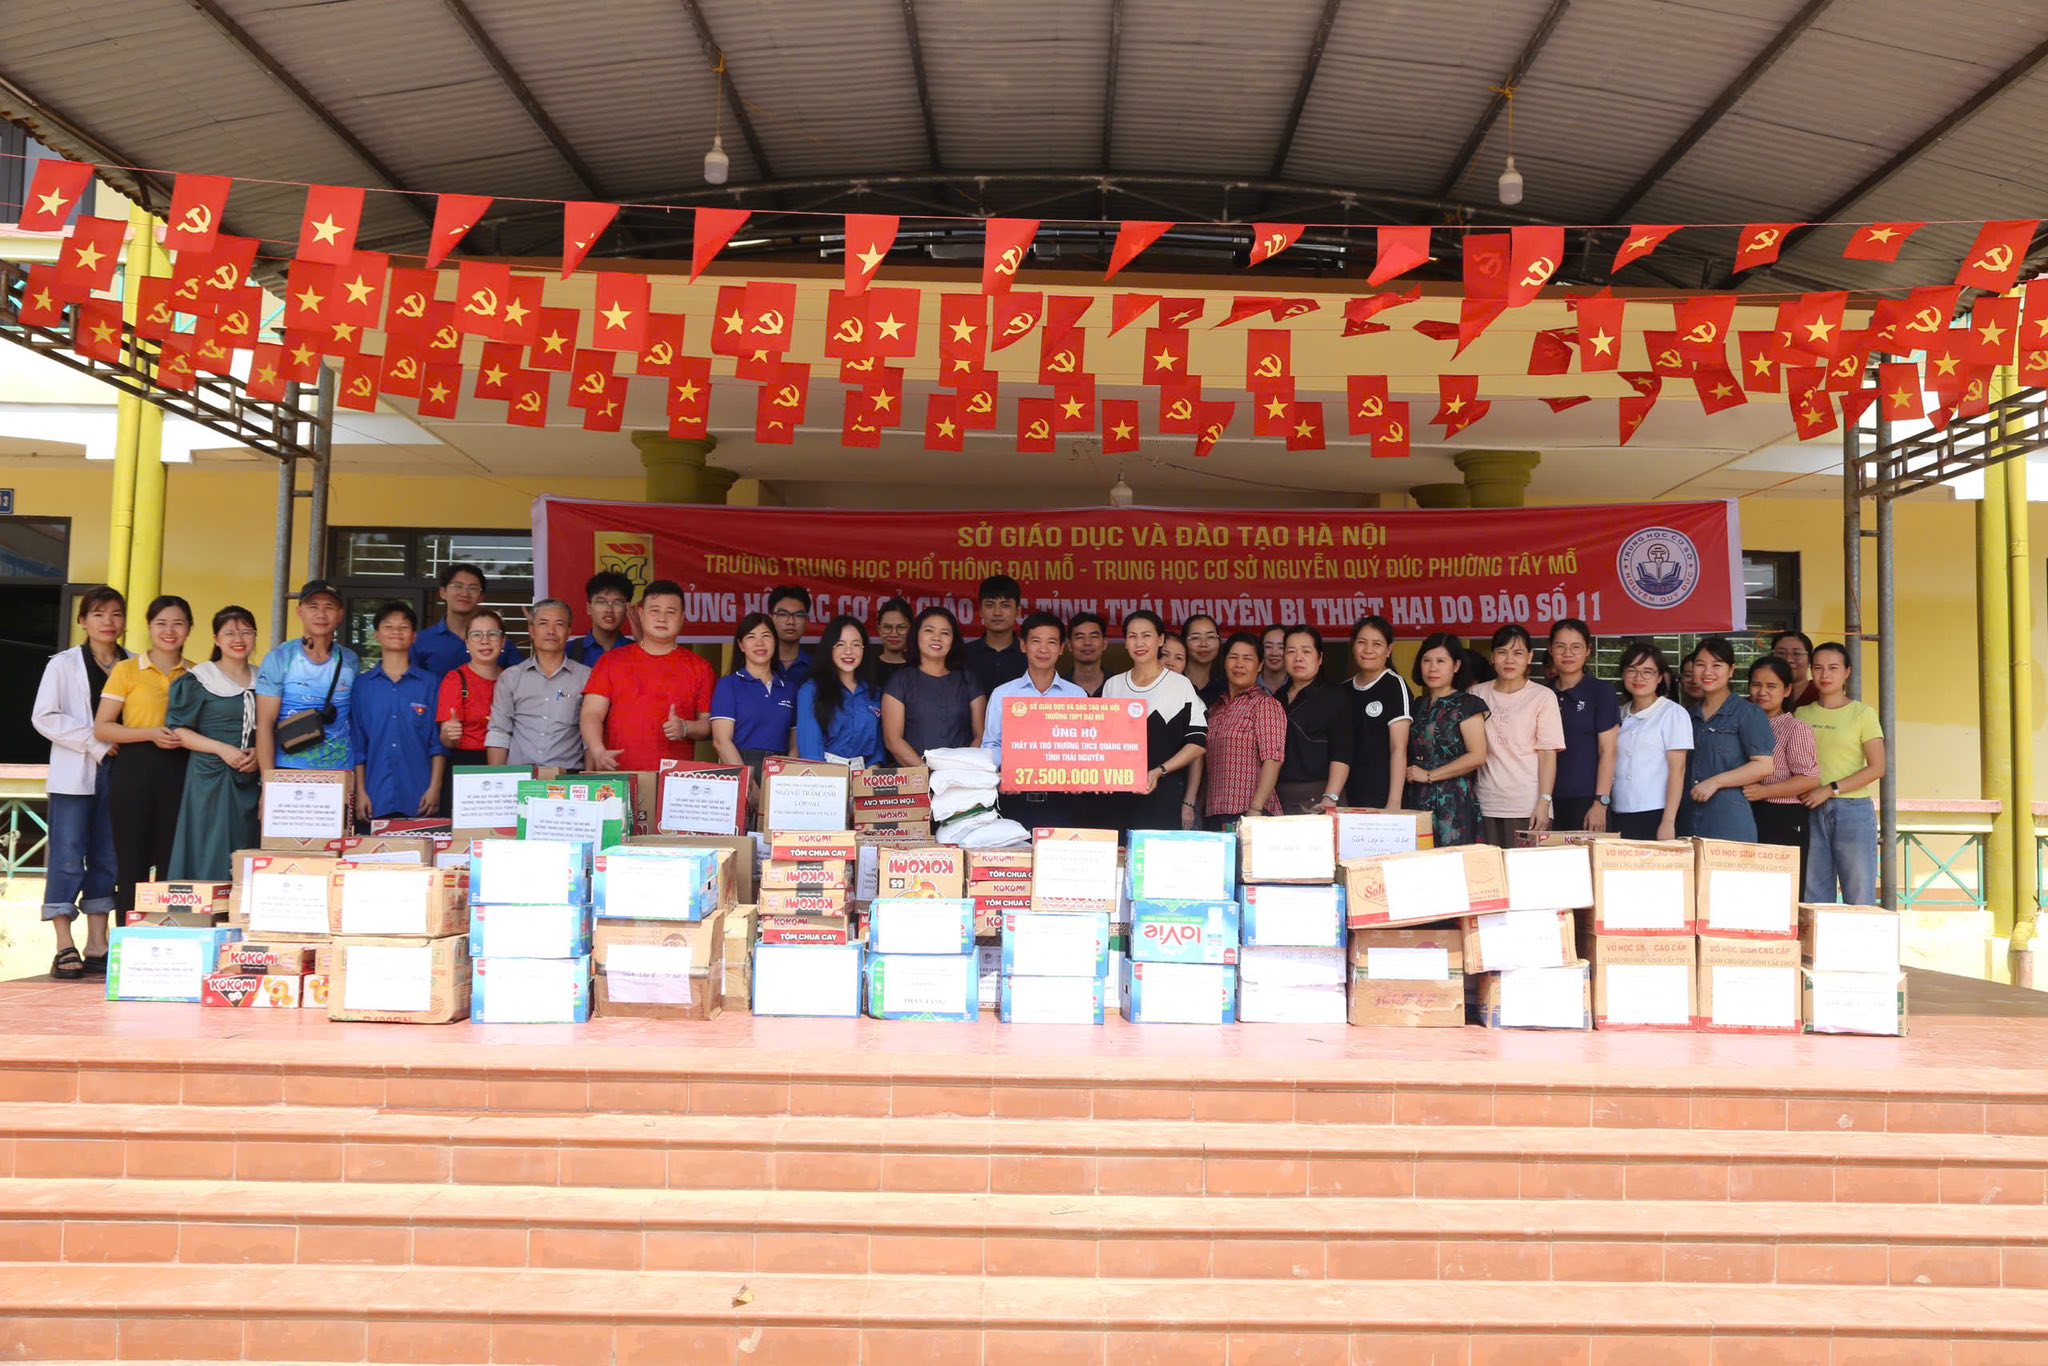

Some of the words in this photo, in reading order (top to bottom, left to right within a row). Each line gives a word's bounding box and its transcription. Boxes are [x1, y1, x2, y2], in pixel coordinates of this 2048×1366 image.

[958, 520, 993, 547] SỞ
[1000, 522, 1062, 547] GIÁO
[1071, 526, 1124, 551] DỤC
[1132, 522, 1167, 547] VÀ
[1176, 522, 1229, 547] ĐÀO
[1237, 526, 1289, 550] TẠO
[1297, 522, 1334, 547] HÀ
[1342, 523, 1387, 549] NỘI
[1624, 537, 1644, 561] TRUNG
[704, 552, 779, 576] TRƯỜNG
[783, 557, 846, 578] TRUNG
[852, 560, 890, 582] HỌC
[896, 552, 935, 580] PHỔ
[939, 556, 1002, 580] THÔNG
[1008, 560, 1040, 584] ĐẠI
[1045, 553, 1075, 580] MỖ
[1093, 560, 1156, 580] TRUNG
[1161, 560, 1198, 584] HỌC
[1204, 559, 1229, 580] CƠ
[1233, 554, 1258, 580] SỞ
[1263, 552, 1338, 579] NGUYỄN
[1343, 555, 1381, 579] QUÝ
[1386, 555, 1424, 578] ĐỨC
[1428, 553, 1503, 578] PHƯỜNG
[1508, 552, 1543, 576] TÂY
[1548, 547, 1578, 575] MỖ
[684, 583, 736, 623] ỦNG
[838, 594, 870, 623] CƠ
[1391, 596, 1434, 630] HẠI
[1441, 596, 1473, 624] DO
[1480, 589, 1530, 624] BÃO
[1536, 583, 1567, 622] SỐ
[1576, 591, 1601, 622] 11
[1052, 725, 1077, 738] ỦNG
[1081, 726, 1097, 740] HỘ
[863, 775, 908, 787] KOKOMI
[1015, 768, 1099, 785] 37.500.000
[1103, 768, 1134, 785] VNĐ
[879, 798, 898, 806] CHUA
[899, 797, 915, 805] TÔM
[878, 811, 908, 819] KOKOMI
[799, 834, 831, 842] KOKOMI
[790, 848, 807, 857] TÔM
[982, 854, 1014, 862] KOKOMI
[888, 859, 954, 873] KOKOMI
[786, 871, 834, 883] KOKOMI
[989, 870, 1005, 878] TÔM
[890, 879, 904, 887] 65
[158, 893, 202, 904] KOKOMI
[785, 898, 833, 910] KOKOMI
[773, 918, 807, 926] KOKOMI
[230, 952, 278, 965] KOKOMI
[211, 979, 255, 991] KOKOMI
[228, 992, 242, 1002] 90
